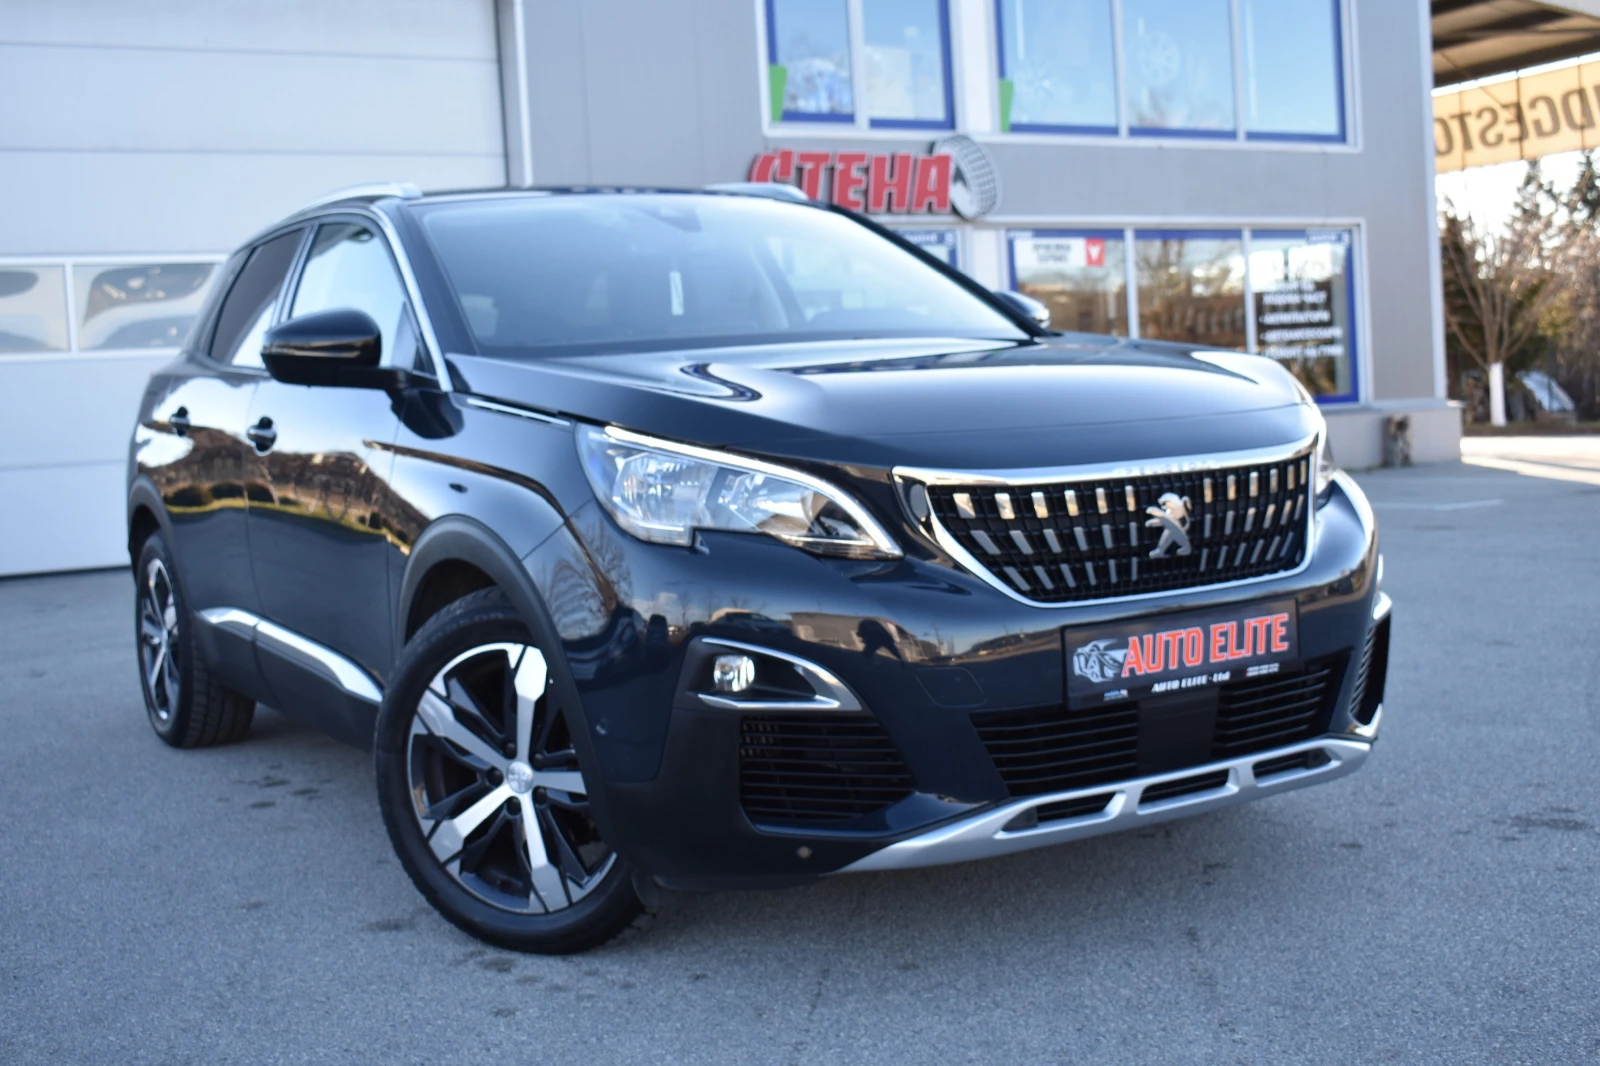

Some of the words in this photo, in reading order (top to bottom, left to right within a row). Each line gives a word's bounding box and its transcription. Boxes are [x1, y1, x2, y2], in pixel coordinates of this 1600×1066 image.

[1121, 627, 1203, 677] AUTO
[1209, 613, 1289, 663] ELITE
[1151, 680, 1180, 693] AUTO
[1181, 675, 1208, 688] ELITE
